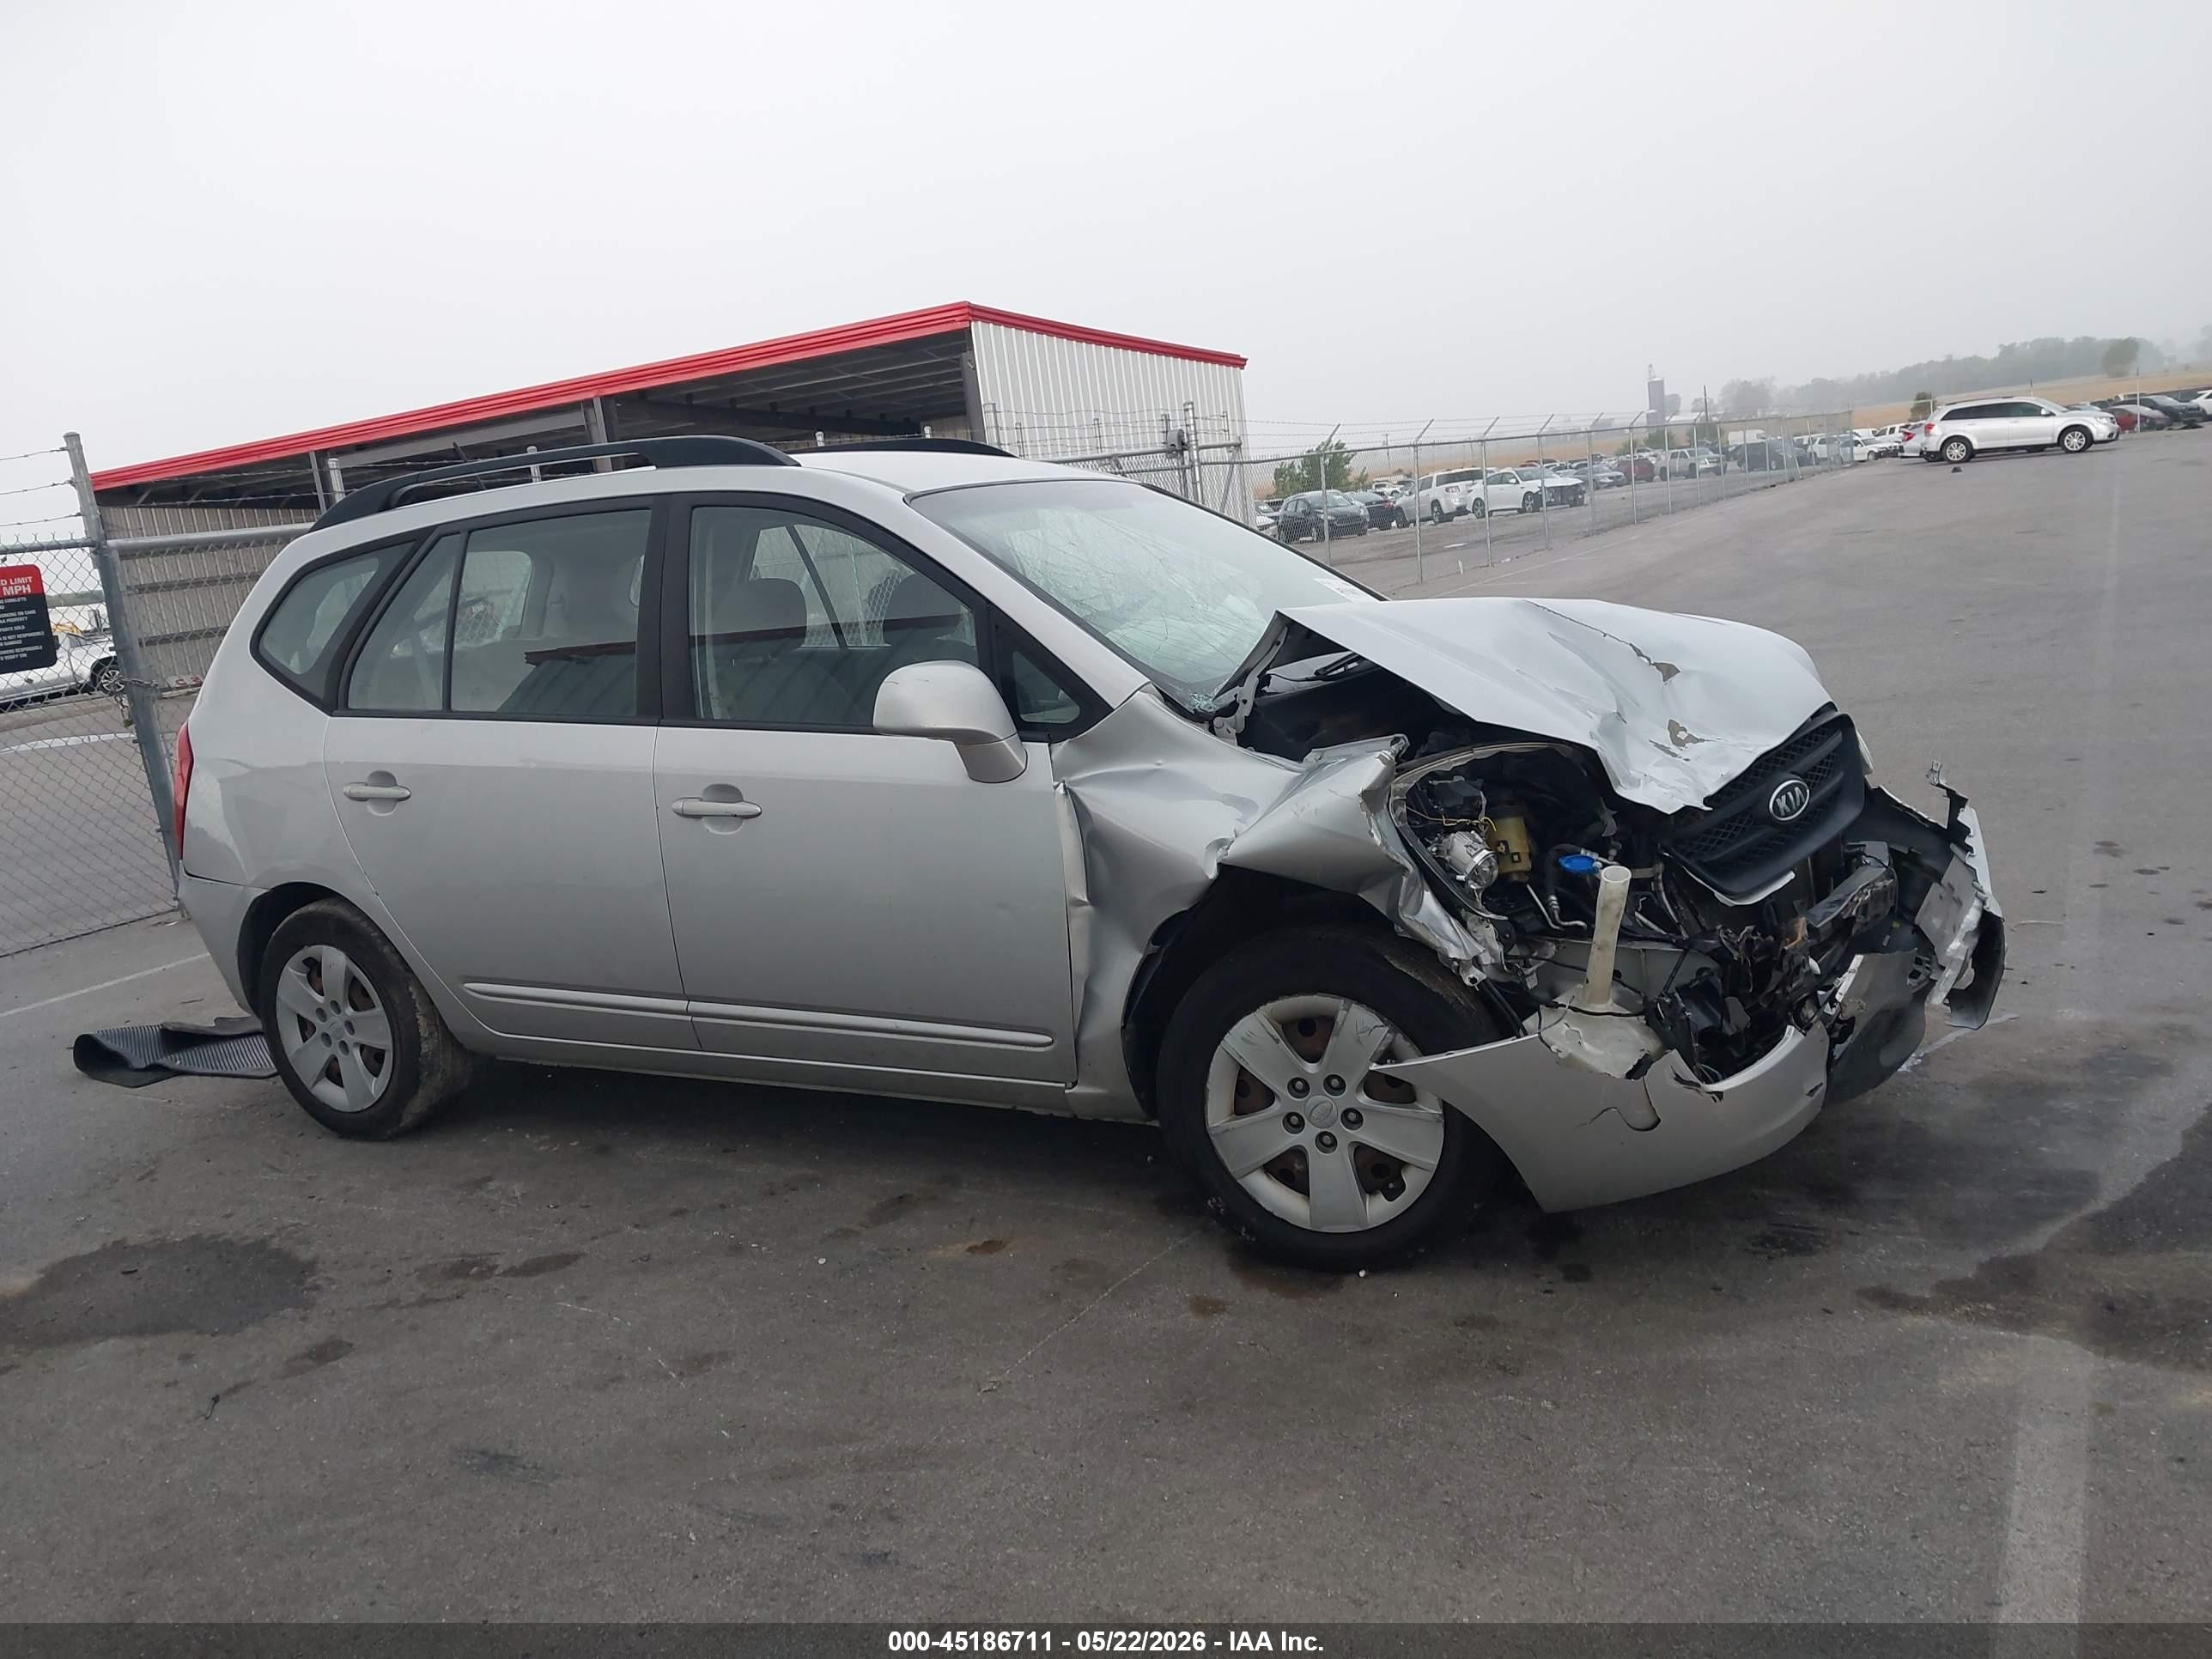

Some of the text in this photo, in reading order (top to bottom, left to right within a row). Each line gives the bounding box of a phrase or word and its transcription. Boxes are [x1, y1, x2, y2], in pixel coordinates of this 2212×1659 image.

[9, 576, 33, 585] LIMIT
[3, 584, 31, 596] MPH
[1774, 785, 1807, 817] KIA
